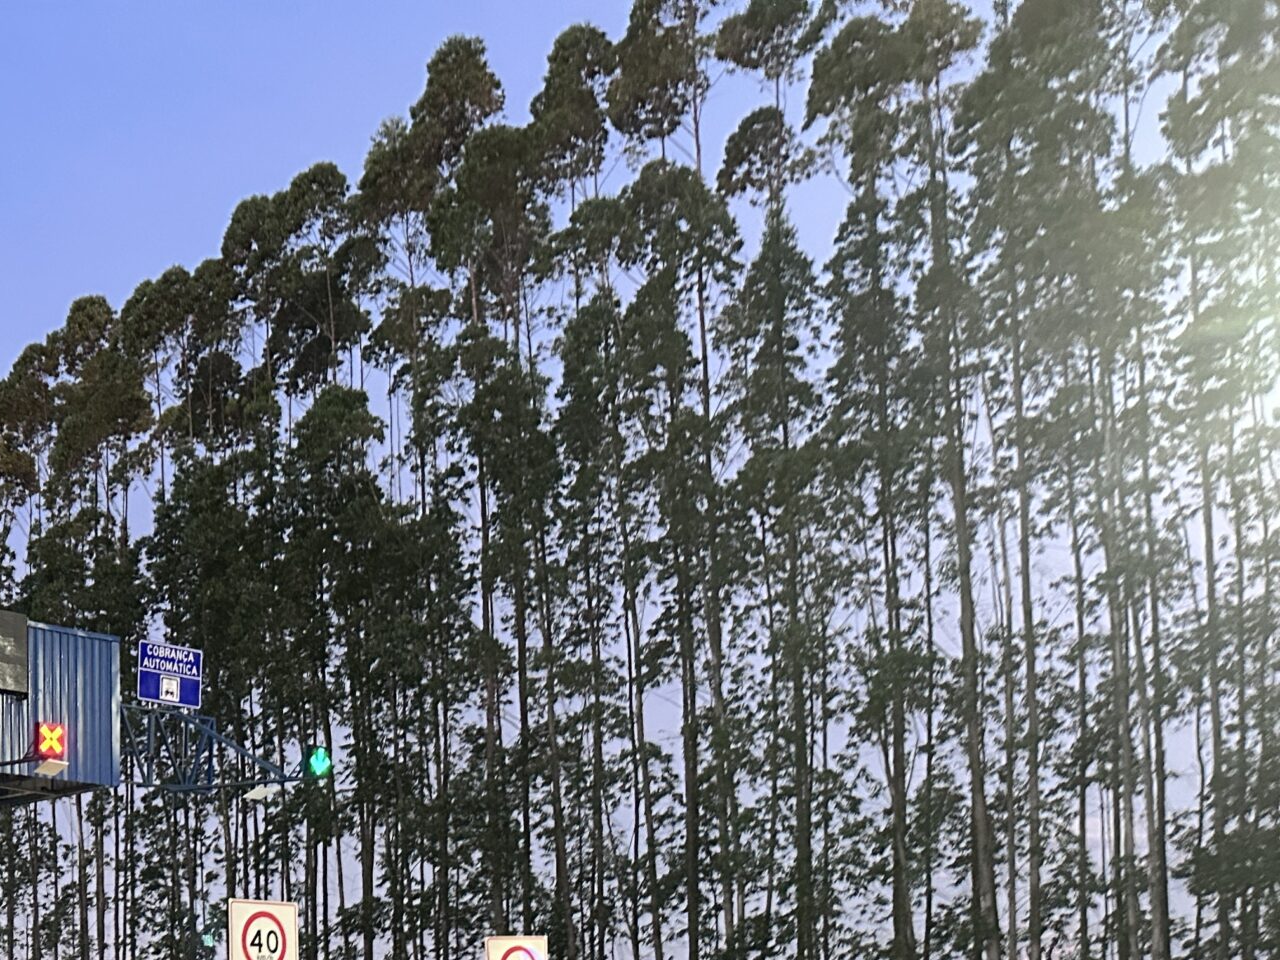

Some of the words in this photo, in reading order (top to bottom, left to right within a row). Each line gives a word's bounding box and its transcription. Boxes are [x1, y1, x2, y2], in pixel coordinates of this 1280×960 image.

[147, 645, 195, 663] COBRANÇA
[143, 657, 198, 676] AUTOMÁTICA
[250, 929, 279, 954] 40
